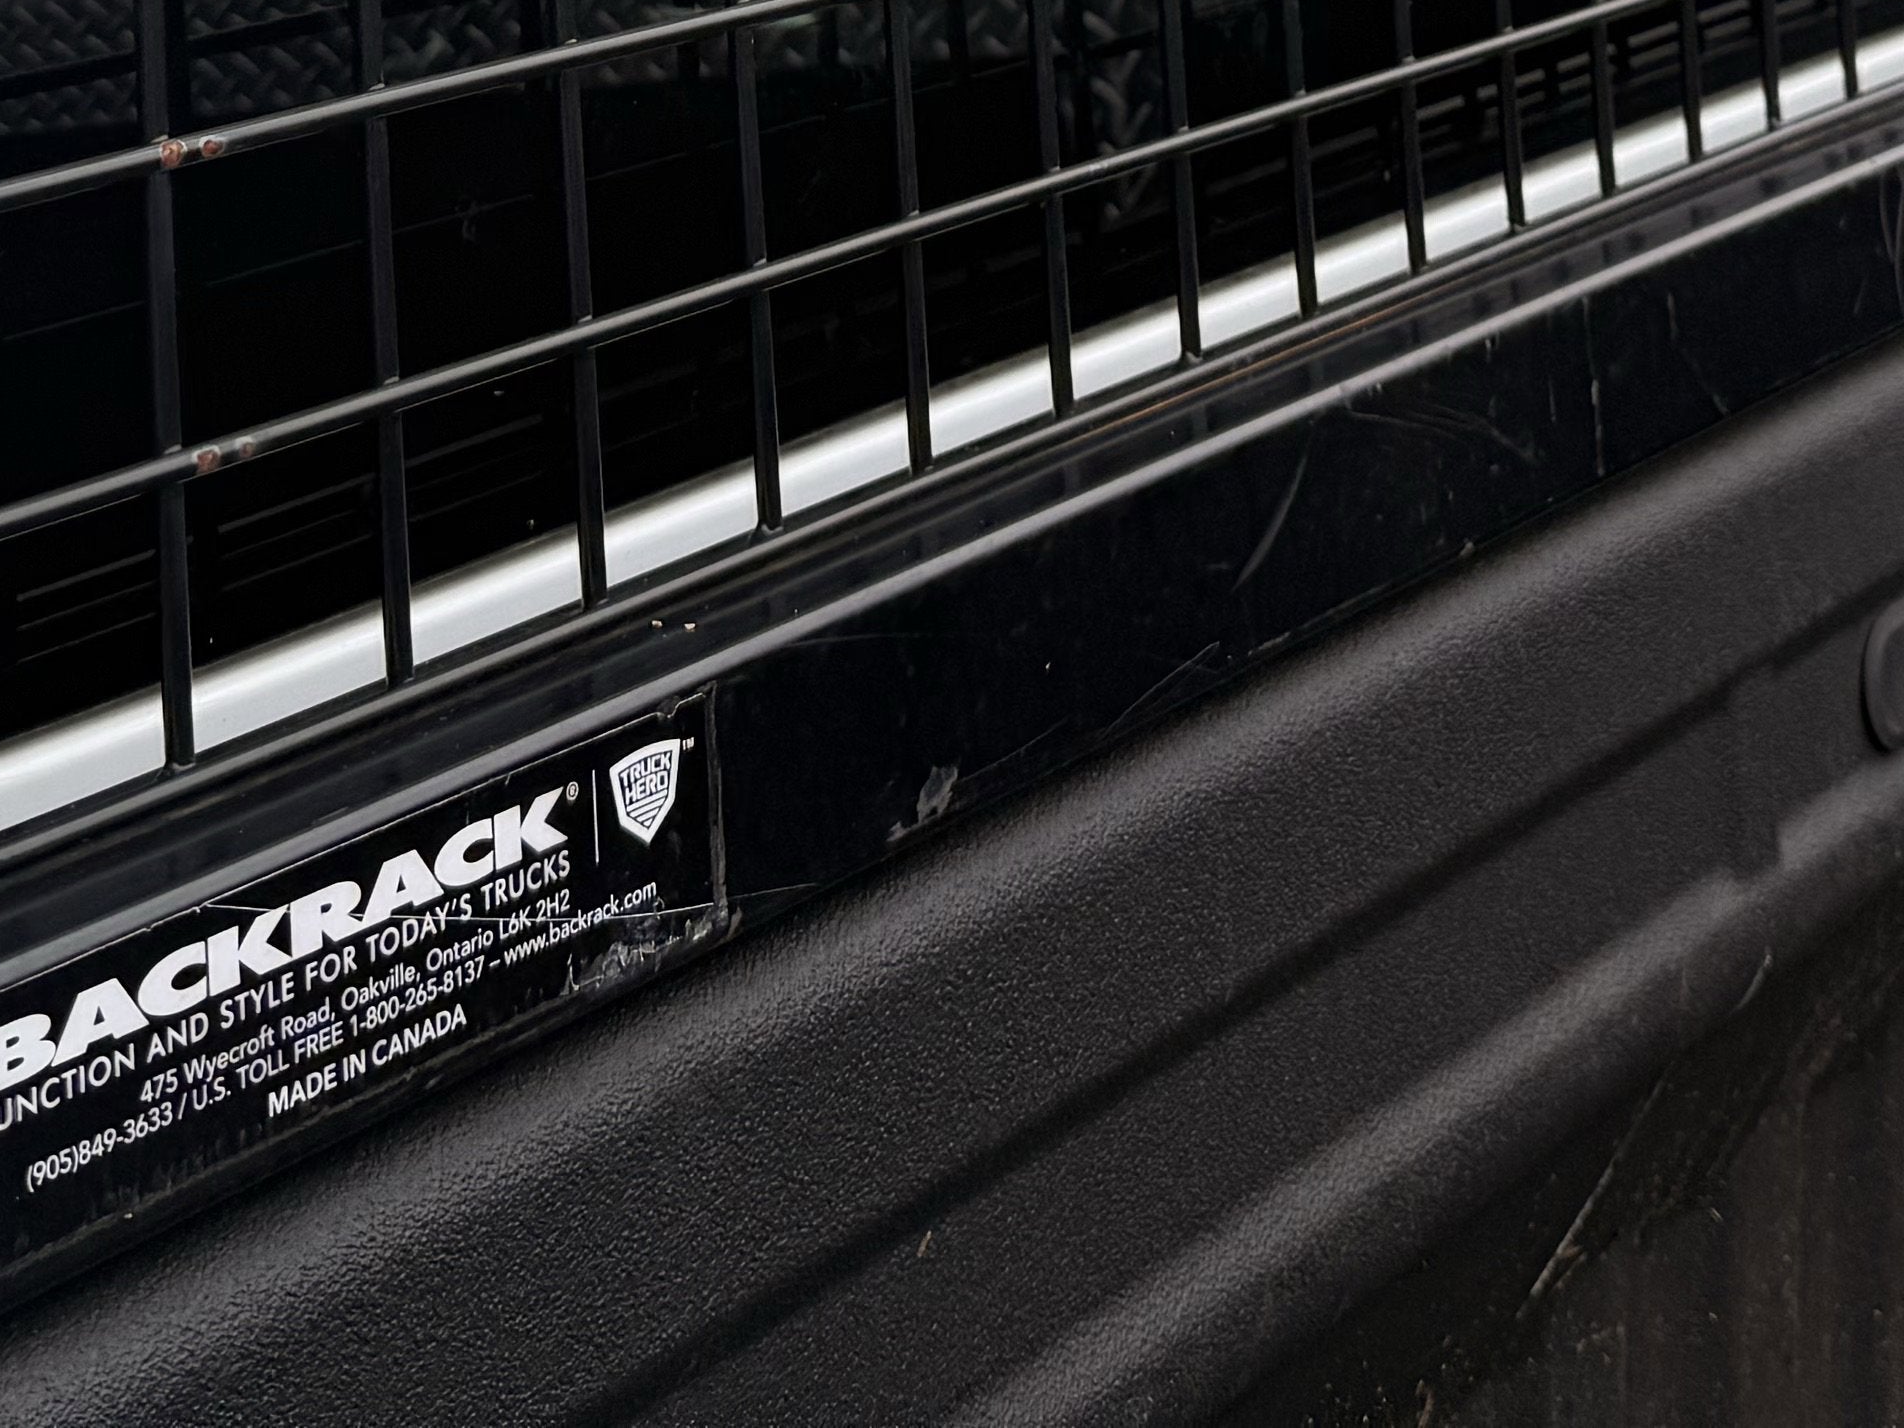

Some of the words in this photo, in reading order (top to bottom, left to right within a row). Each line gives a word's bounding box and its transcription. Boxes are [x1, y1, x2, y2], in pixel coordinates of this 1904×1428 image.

[619, 751, 671, 788] TRUCK
[624, 770, 669, 805] HERO
[24, 1102, 174, 1192] (905)849-3633
[191, 1077, 231, 1111] U.S.
[236, 1048, 290, 1089] TOLL
[293, 1020, 344, 1064] FREE
[349, 953, 485, 1037] 1-800-265-8137
[503, 881, 658, 968] www.backrack.com
[140, 1068, 178, 1103] 475
[183, 1025, 275, 1082] Wyecroft
[281, 995, 337, 1036] Road,
[340, 961, 422, 1012] Oakville,
[426, 929, 493, 973] Ontario
[499, 910, 532, 940] L6K
[536, 888, 571, 922] 2H2
[147, 1011, 209, 1063] AND
[220, 972, 294, 1030] STYLE
[304, 945, 357, 992] FOR
[365, 892, 472, 964] TODAY'S
[480, 850, 571, 912] TRUCKS
[267, 1068, 338, 1118] MADE
[342, 1050, 366, 1085] IN
[371, 1002, 467, 1068] CANADA
